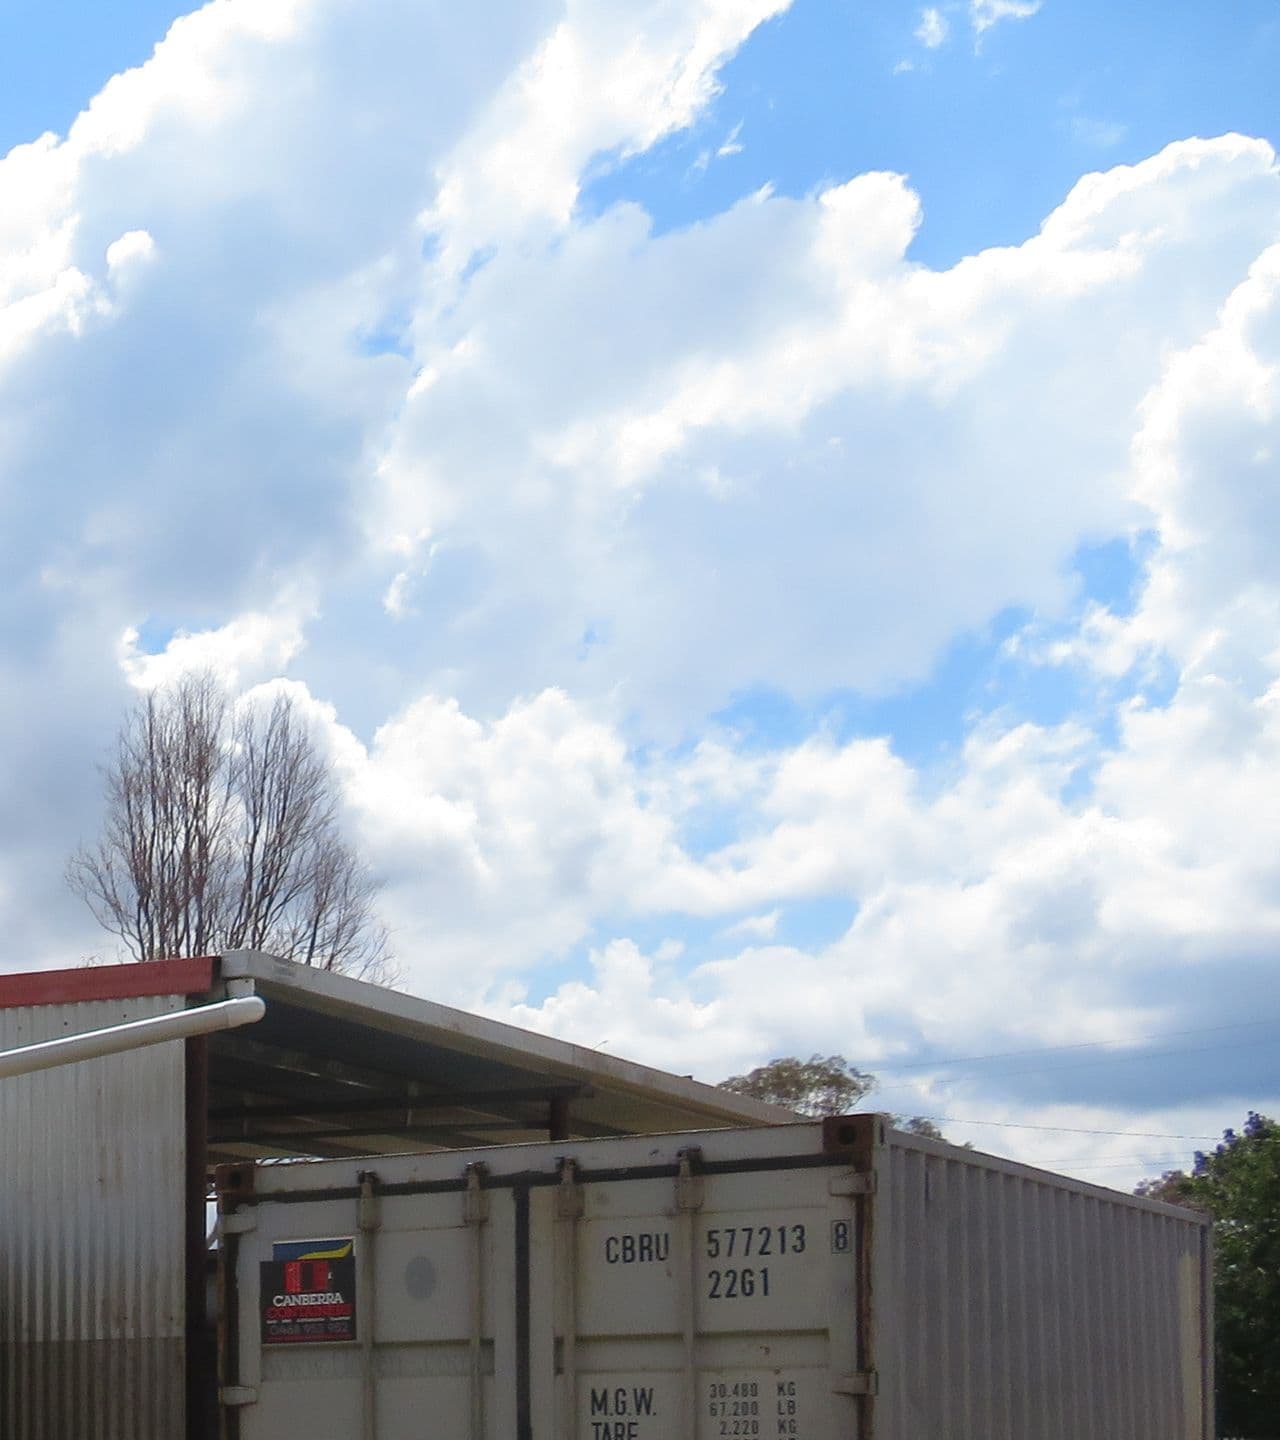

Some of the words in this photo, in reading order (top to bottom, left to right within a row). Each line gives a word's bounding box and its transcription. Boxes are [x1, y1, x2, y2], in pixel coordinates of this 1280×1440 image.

[605, 1233, 670, 1263] CBRU
[706, 1224, 808, 1259] 577213
[834, 1222, 849, 1252] 8
[707, 1267, 770, 1299] 22G1
[272, 1292, 345, 1307] CANBERRA
[590, 1387, 657, 1417] M.G.W.
[709, 1382, 759, 1399] 30.480
[776, 1381, 797, 1396] KG
[777, 1400, 797, 1416] LB
[719, 1420, 760, 1436] 2.220
[777, 1419, 798, 1434] KG
